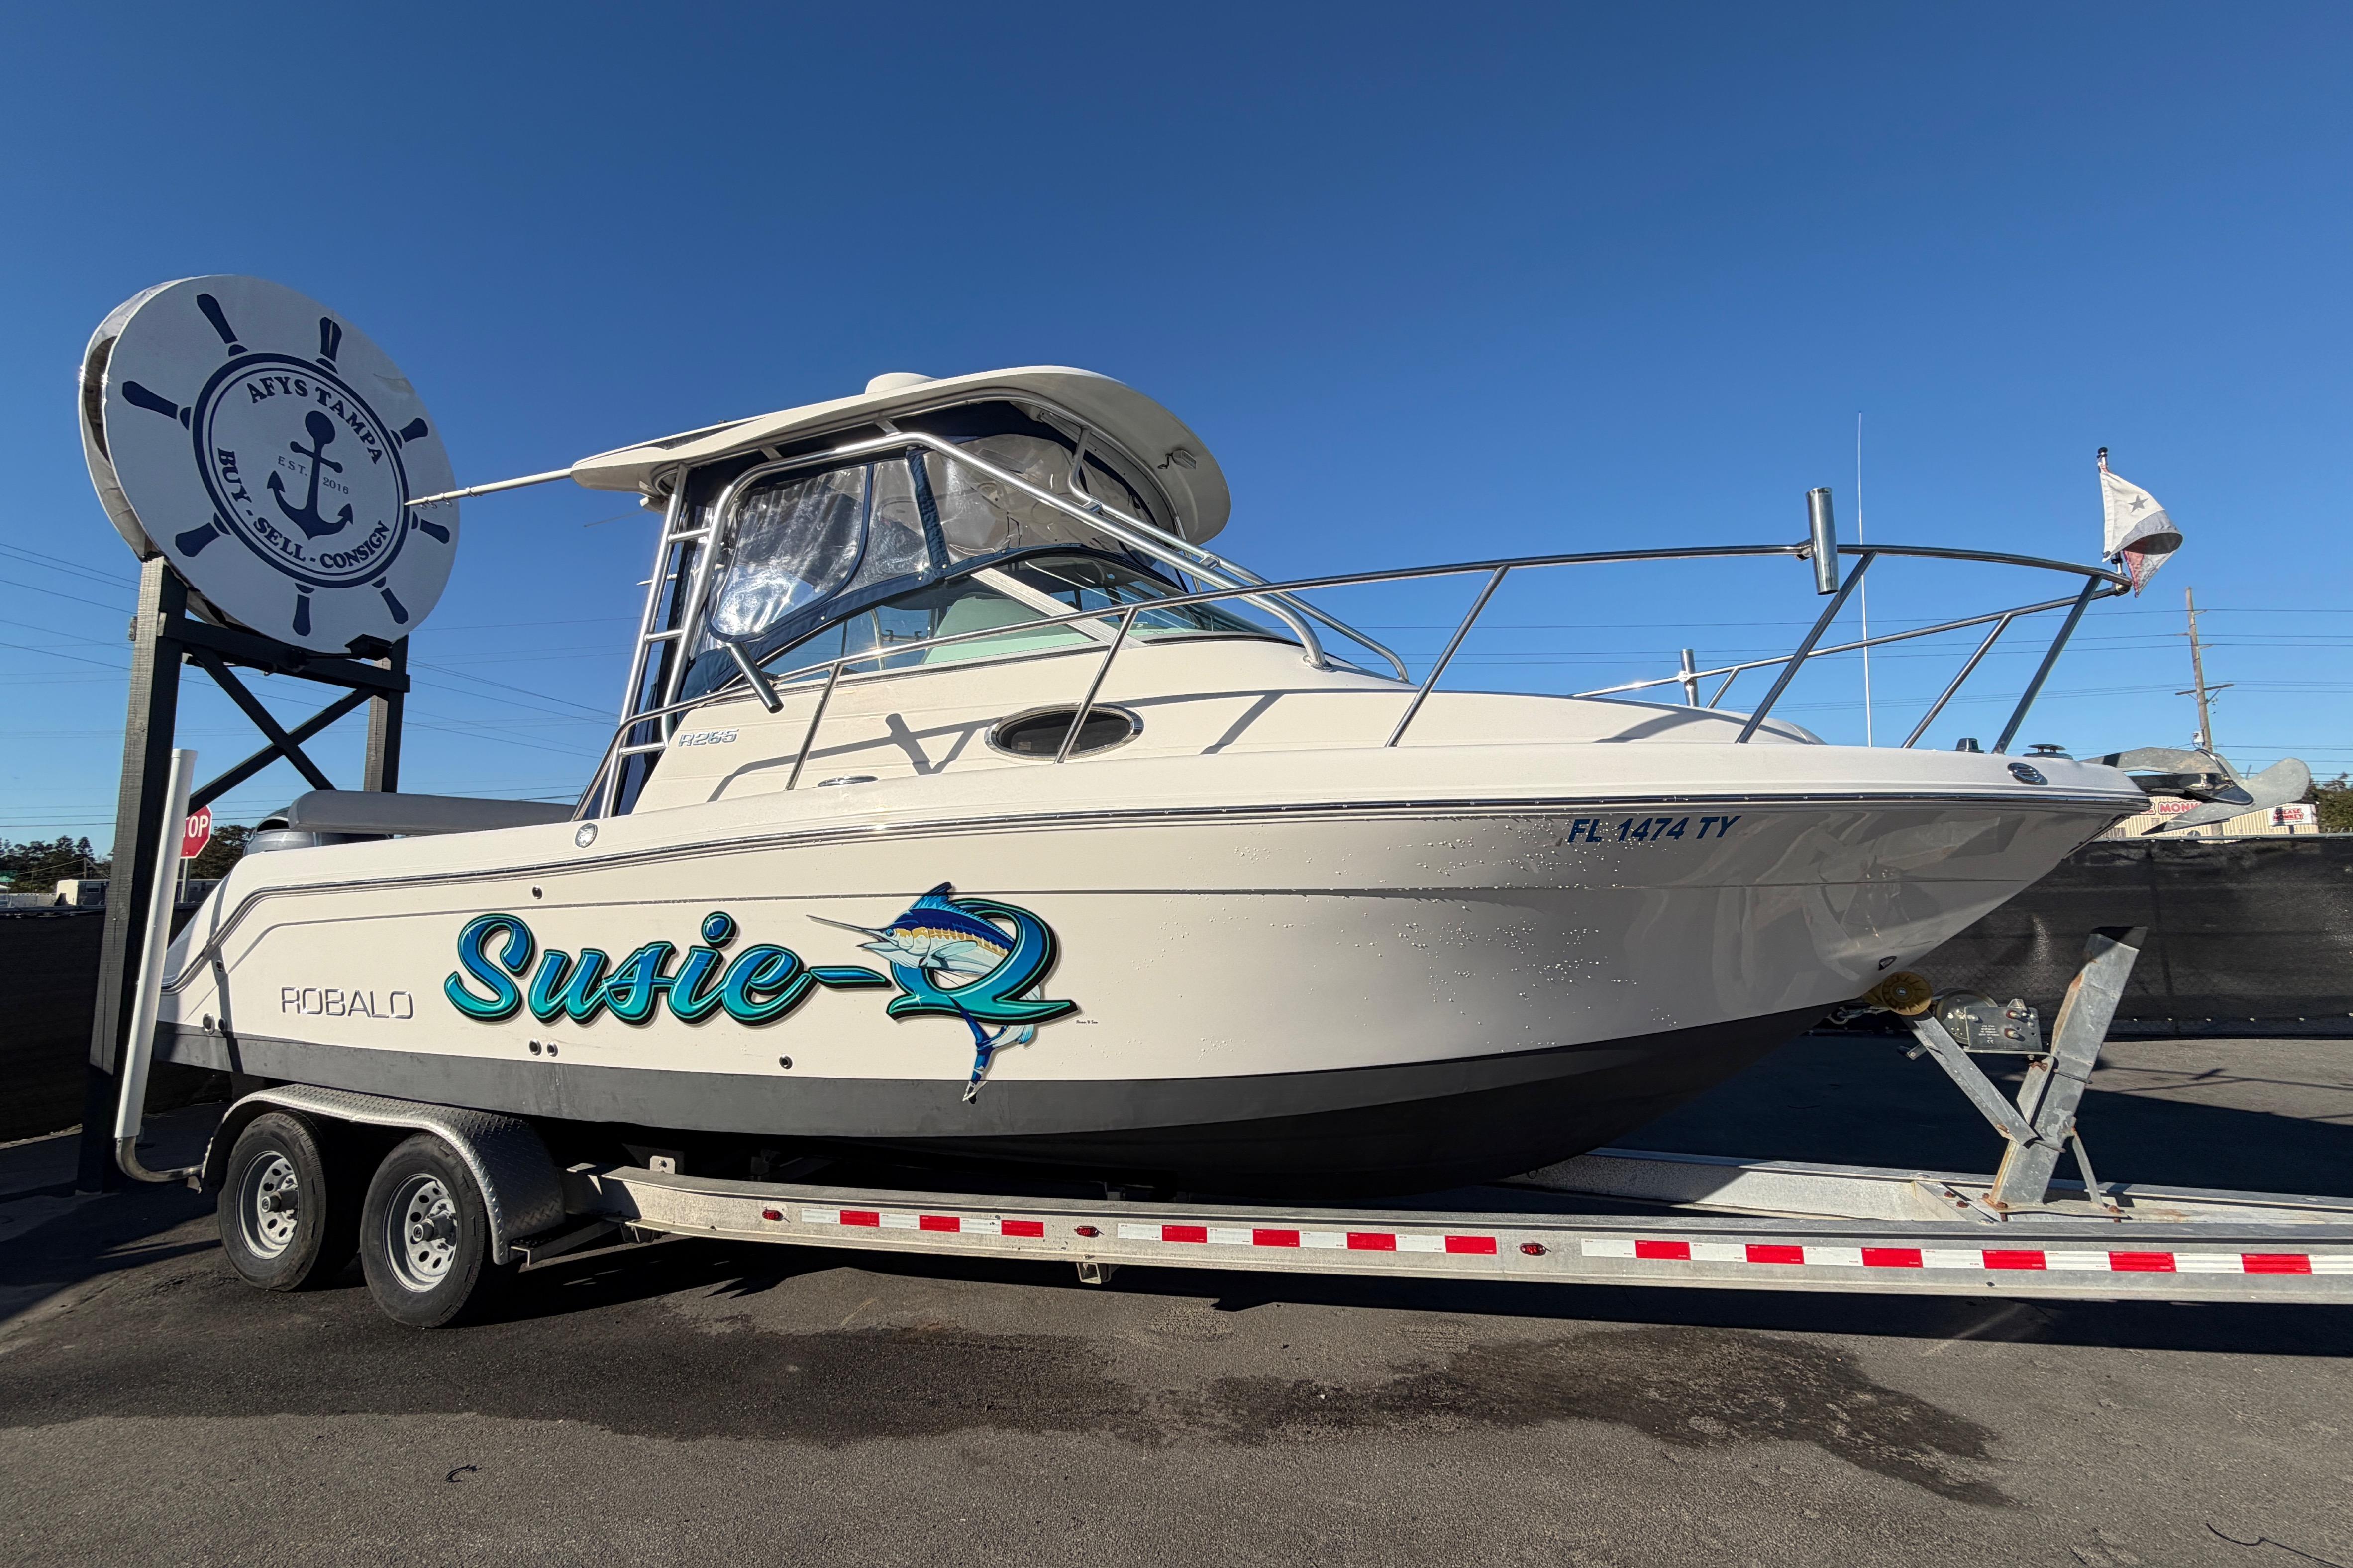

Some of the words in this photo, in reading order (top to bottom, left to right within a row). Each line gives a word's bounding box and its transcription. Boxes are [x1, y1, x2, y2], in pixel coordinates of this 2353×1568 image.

[247, 376, 308, 404] AFYS
[315, 386, 383, 465] TAMPA
[277, 455, 308, 476] EST.
[322, 477, 349, 494] 2016
[217, 447, 252, 503] BUY
[253, 517, 307, 563] SELL
[319, 520, 390, 569] CONSIGN
[678, 728, 740, 747] R265
[183, 815, 209, 838] OP
[1567, 819, 1603, 843] FL
[1617, 817, 1690, 843] 1474
[1697, 815, 1741, 839] TY
[281, 987, 414, 1019] ROBALO
